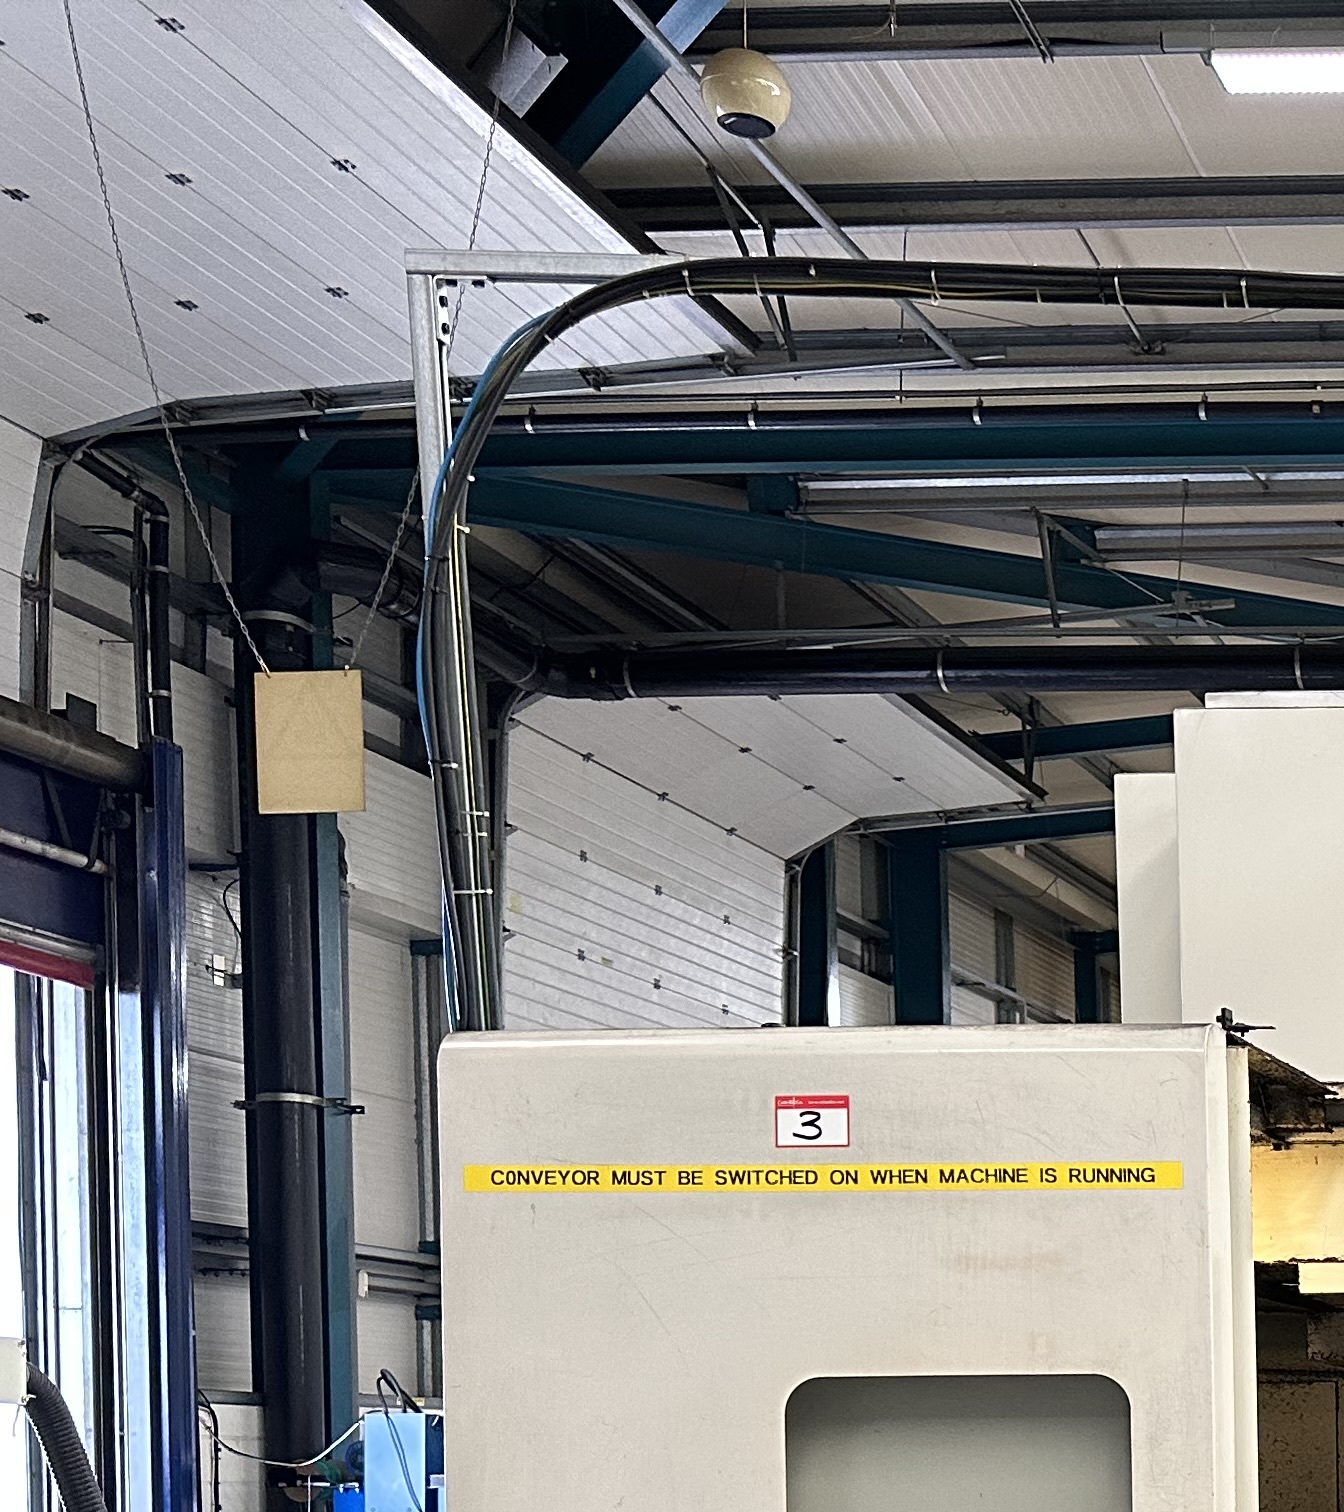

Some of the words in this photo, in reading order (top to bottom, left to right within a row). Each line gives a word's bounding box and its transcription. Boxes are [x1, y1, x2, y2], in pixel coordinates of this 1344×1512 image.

[792, 1110, 822, 1140] 3
[611, 1169, 667, 1185] MUST
[678, 1169, 703, 1185] BE
[714, 1169, 819, 1186] SWITCHED
[829, 1169, 859, 1185] ON
[869, 1168, 928, 1185] WHEN
[939, 1167, 1028, 1184] MACHINE
[1039, 1167, 1058, 1183] IS
[1068, 1167, 1156, 1183] RUNNING
